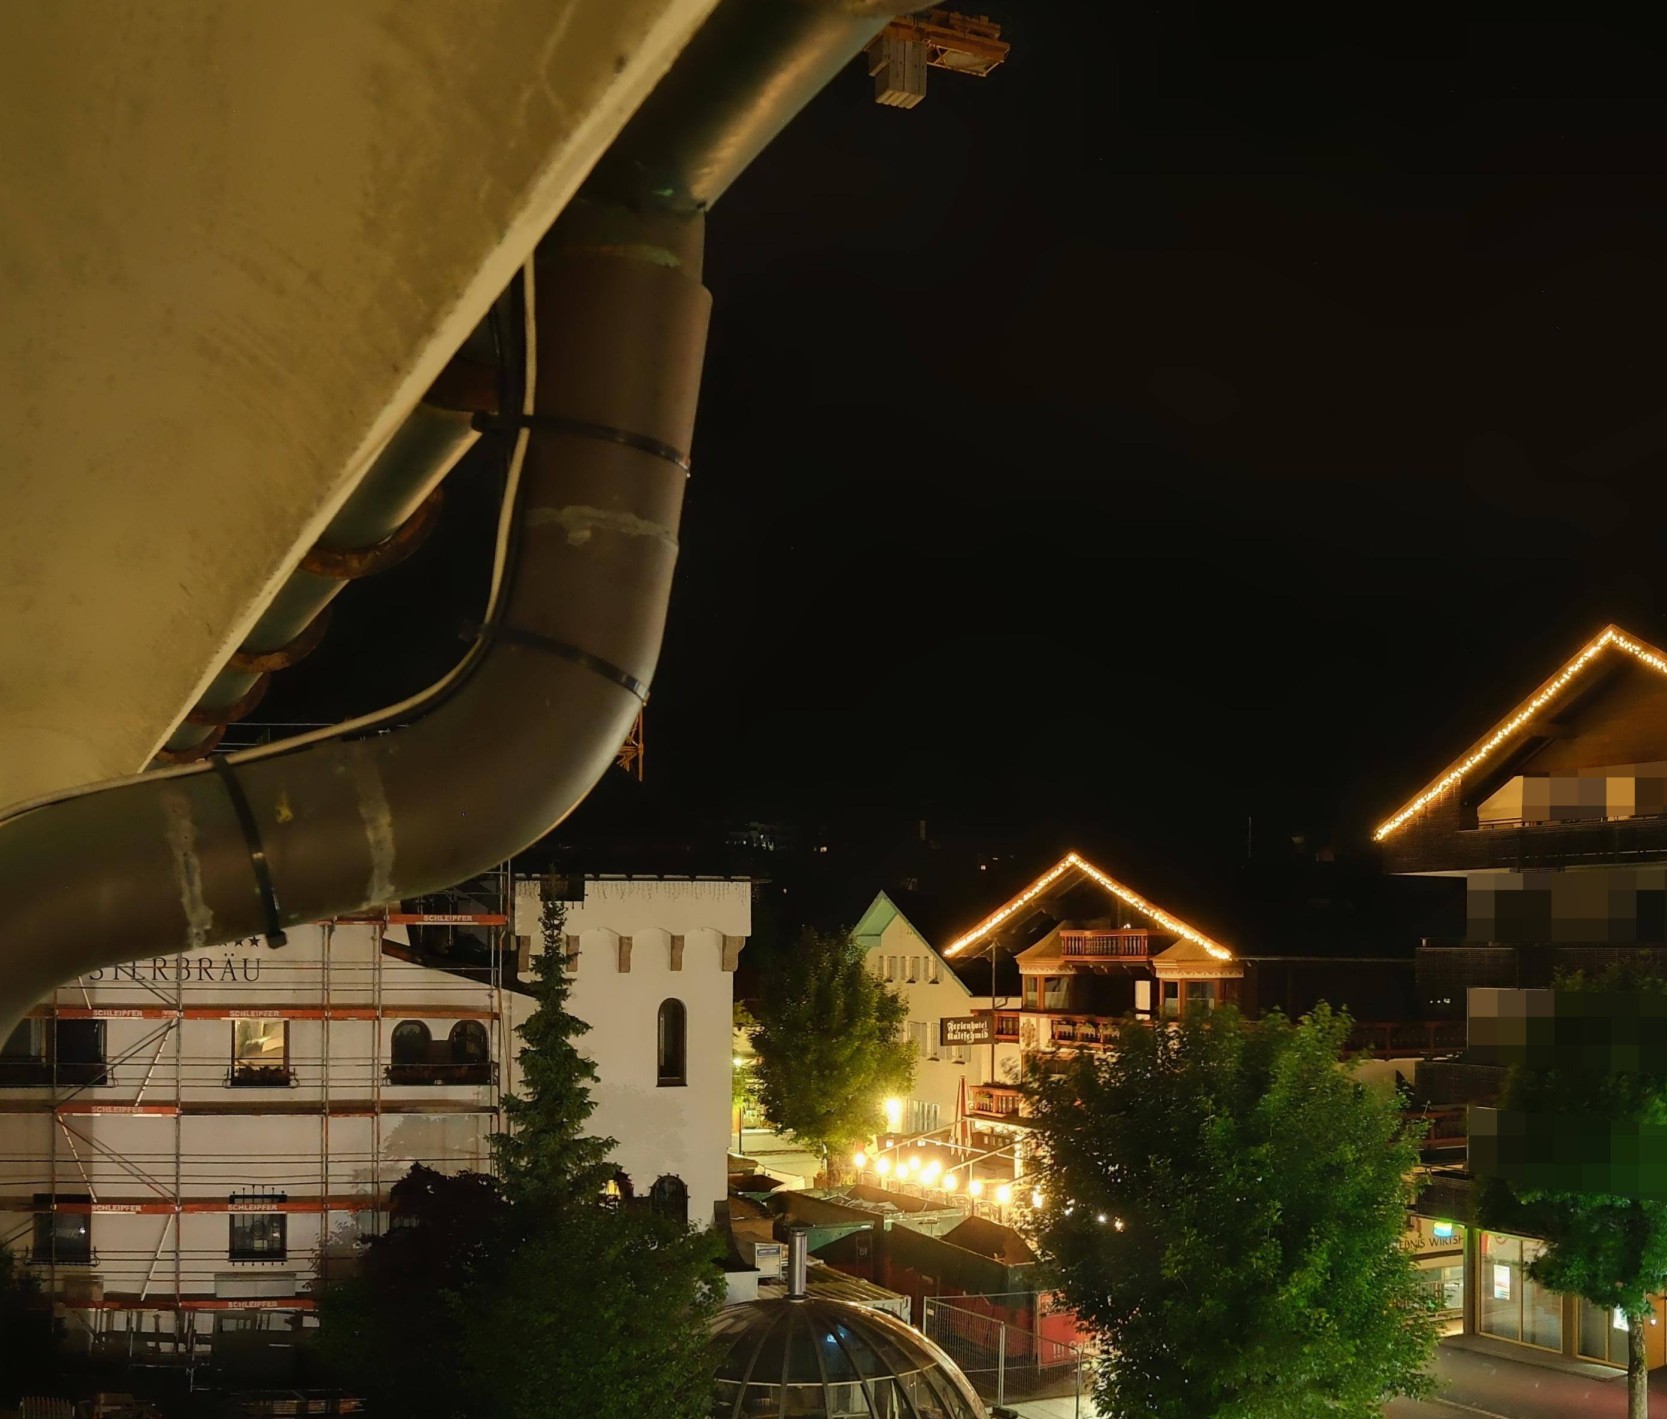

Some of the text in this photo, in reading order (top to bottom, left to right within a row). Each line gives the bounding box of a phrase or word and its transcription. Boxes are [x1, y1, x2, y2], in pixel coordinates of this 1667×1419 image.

[422, 914, 473, 922] SCHLEIPFER
[92, 1009, 143, 1017] SCHLEIPFER
[229, 1010, 280, 1018] SCHLEIPFER
[91, 1106, 144, 1114] SCHLEIPFER
[91, 1204, 142, 1212] SCHLEIPFER
